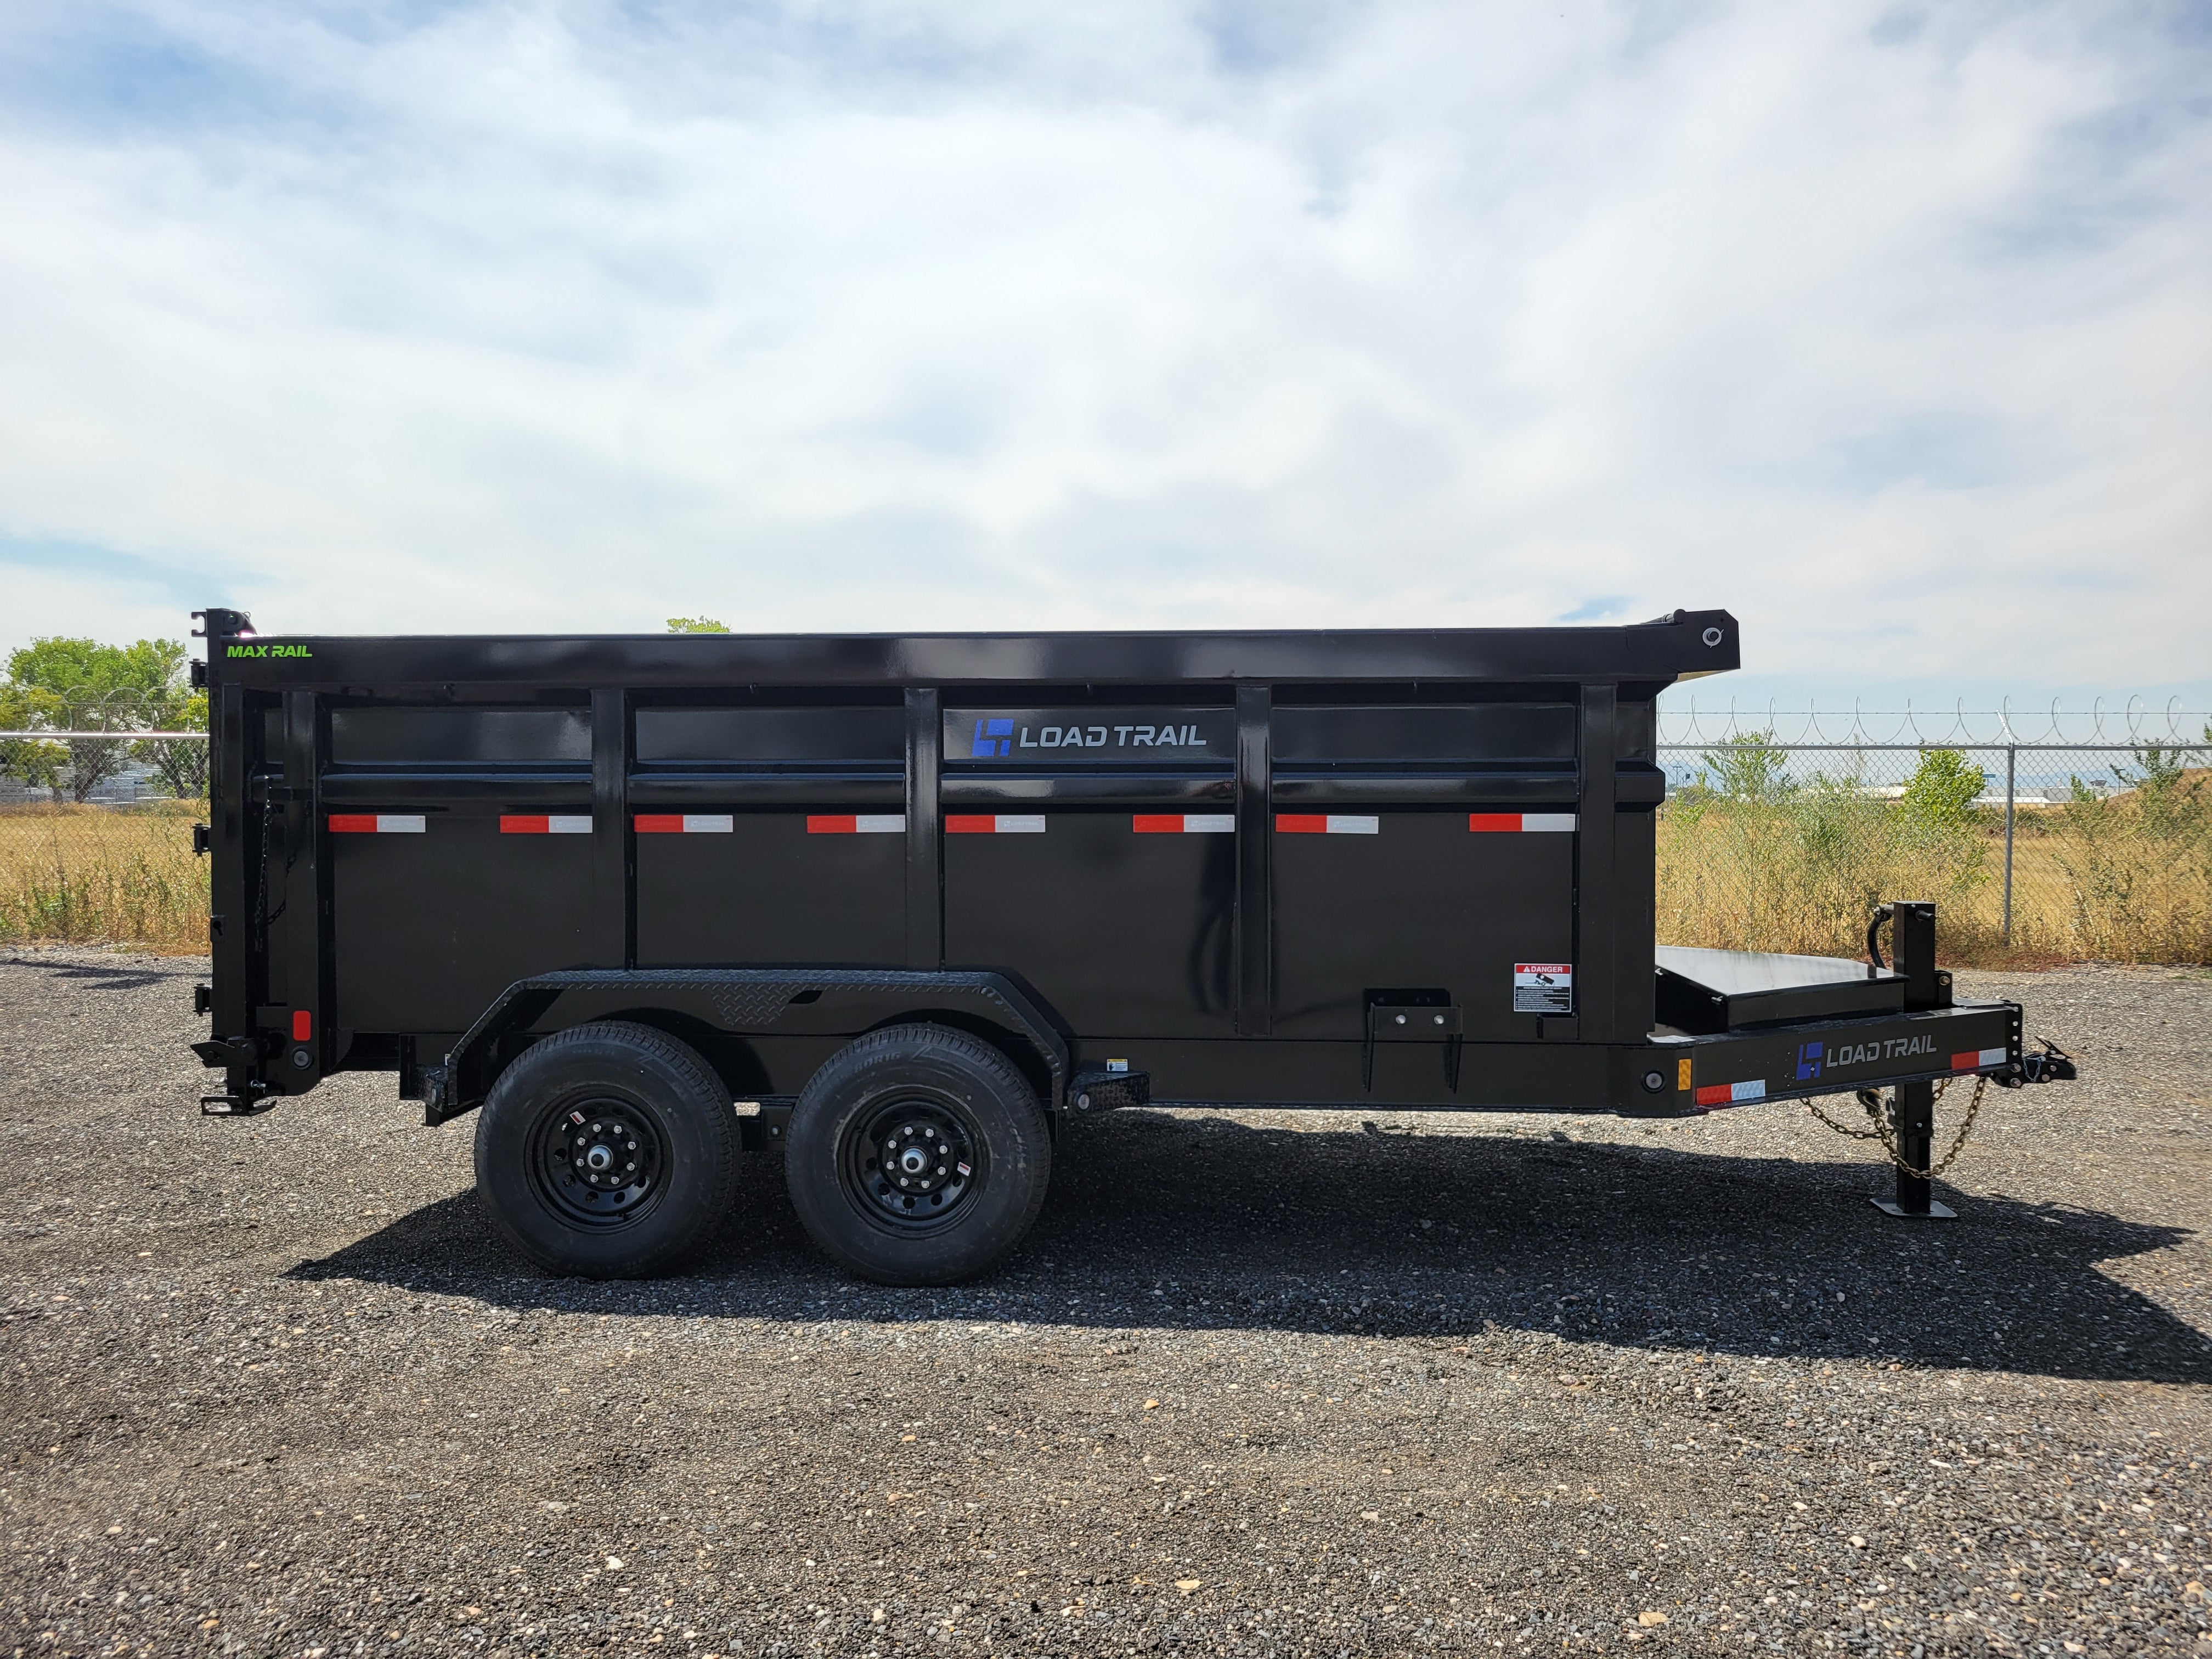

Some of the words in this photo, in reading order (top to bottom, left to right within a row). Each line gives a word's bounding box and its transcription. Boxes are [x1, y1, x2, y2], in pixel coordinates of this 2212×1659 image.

[227, 646, 268, 657] MAX
[272, 646, 312, 657] RAIL
[1019, 726, 1108, 748] LOAD
[1114, 725, 1206, 746] TRAIL
[1826, 1042, 1880, 1068] LOAD
[1883, 1035, 1937, 1059] TRAIL
